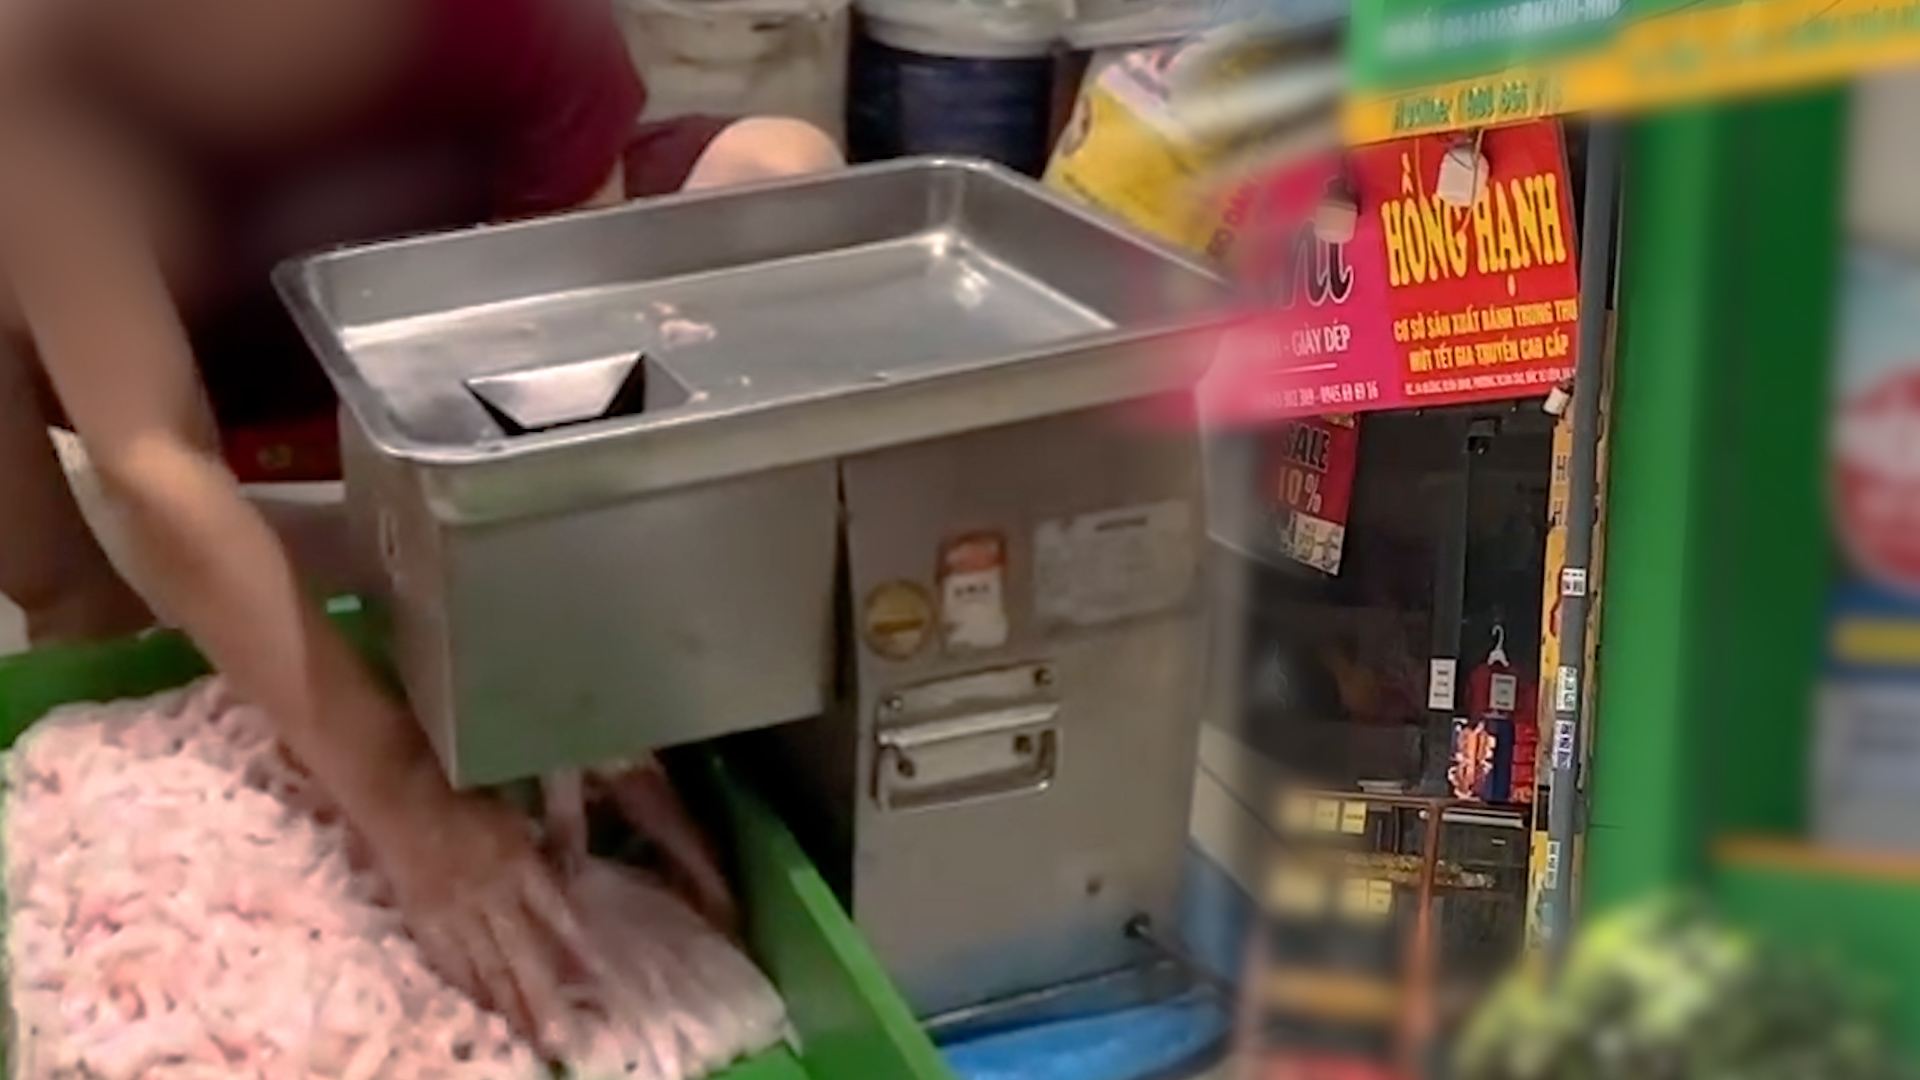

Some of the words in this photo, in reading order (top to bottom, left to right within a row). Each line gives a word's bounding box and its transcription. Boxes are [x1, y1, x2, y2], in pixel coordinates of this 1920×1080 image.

[1381, 152, 1467, 288] HỒNG
[1473, 172, 1567, 297] HẠNH
[1514, 301, 1554, 328] TRUNG
[1454, 345, 1476, 368] GIA
[1520, 336, 1545, 361] CAO
[1545, 326, 1569, 357] CẤP
